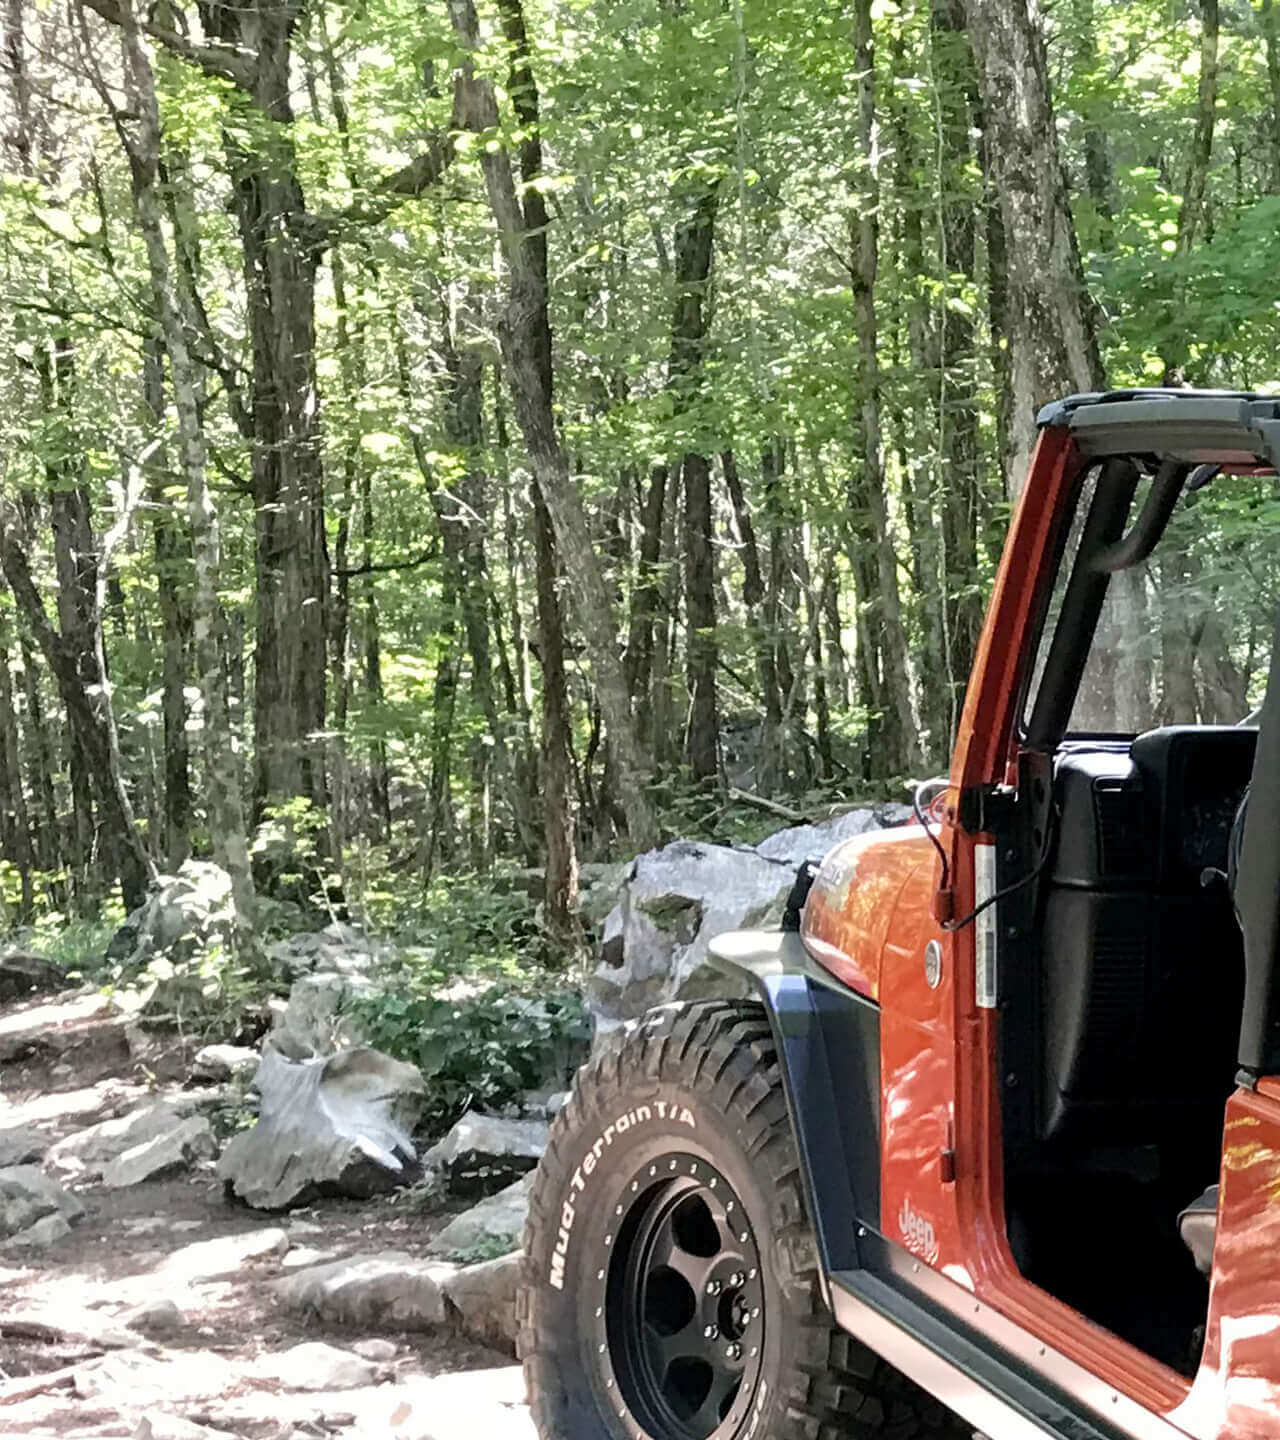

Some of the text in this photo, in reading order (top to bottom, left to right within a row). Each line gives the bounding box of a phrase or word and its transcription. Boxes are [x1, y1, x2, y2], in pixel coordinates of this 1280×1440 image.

[548, 1100, 696, 1291] Mud-Terrain T/A
[899, 1197, 936, 1259] Jeep
